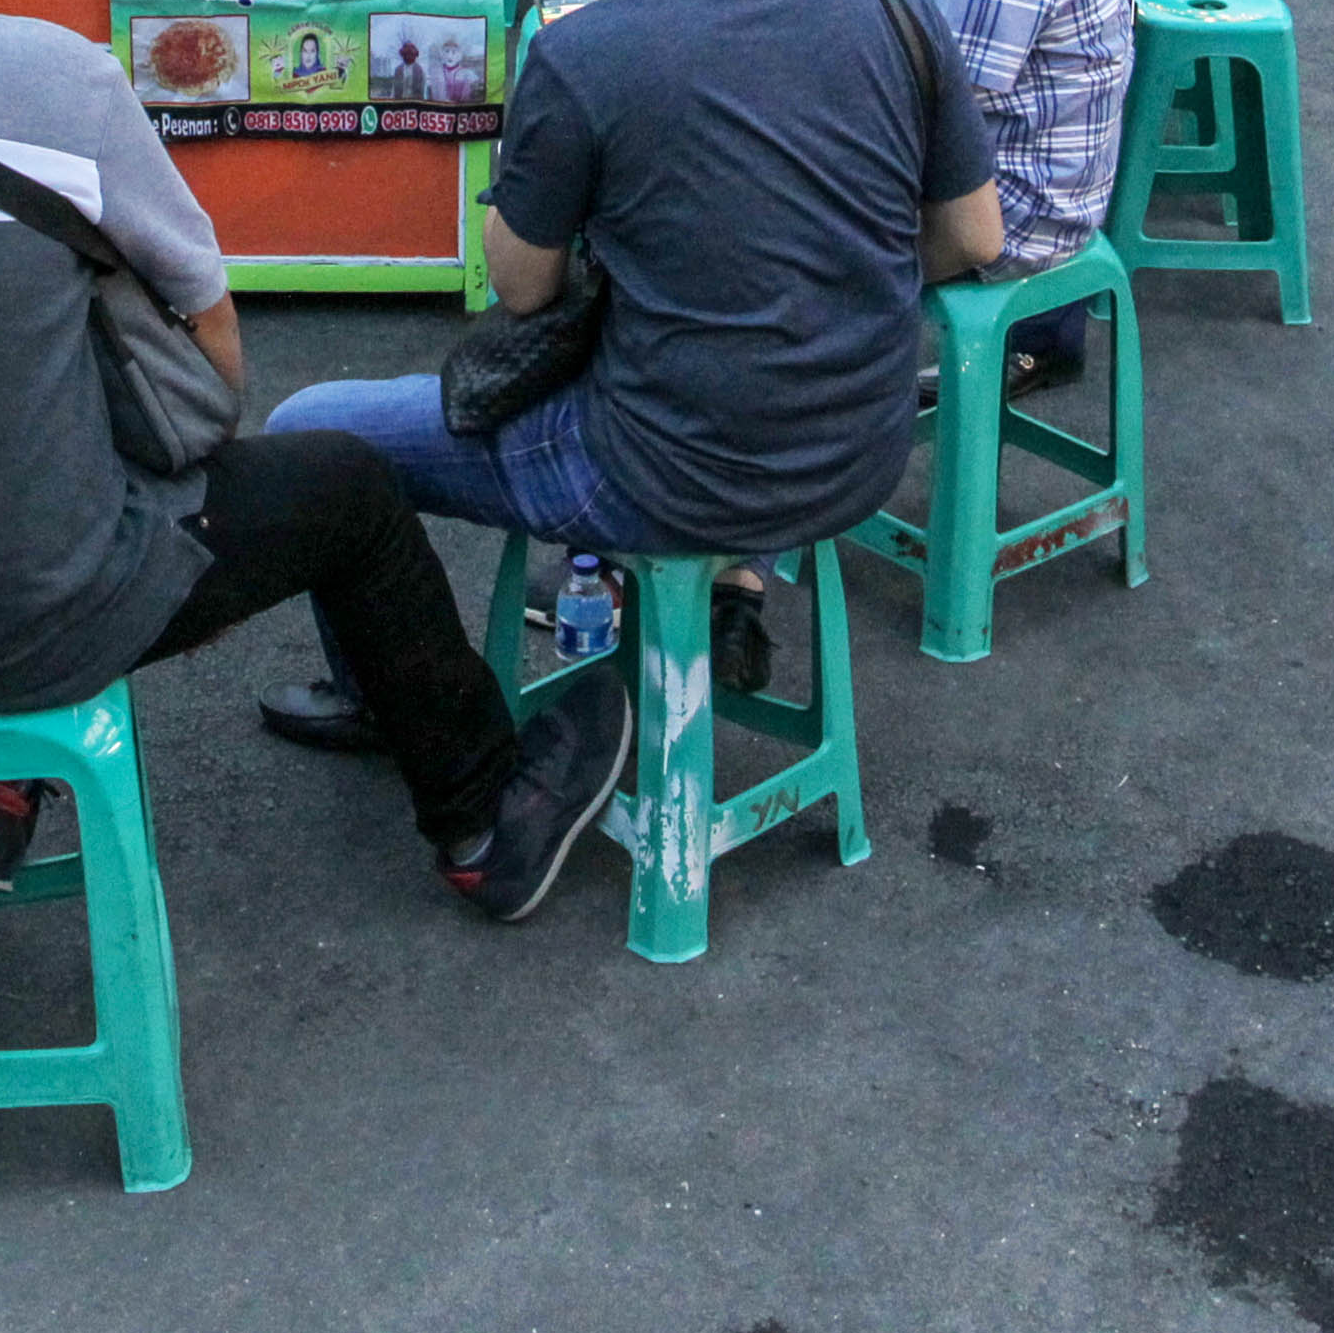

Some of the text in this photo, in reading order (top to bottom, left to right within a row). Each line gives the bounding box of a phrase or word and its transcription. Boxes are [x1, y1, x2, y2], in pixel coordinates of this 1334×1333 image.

[244, 111, 281, 131] 0813
[283, 110, 318, 132] 8519
[319, 110, 358, 132] 9919
[381, 109, 417, 131] 0815
[419, 111, 456, 134] 8557
[457, 112, 498, 134] 5499
